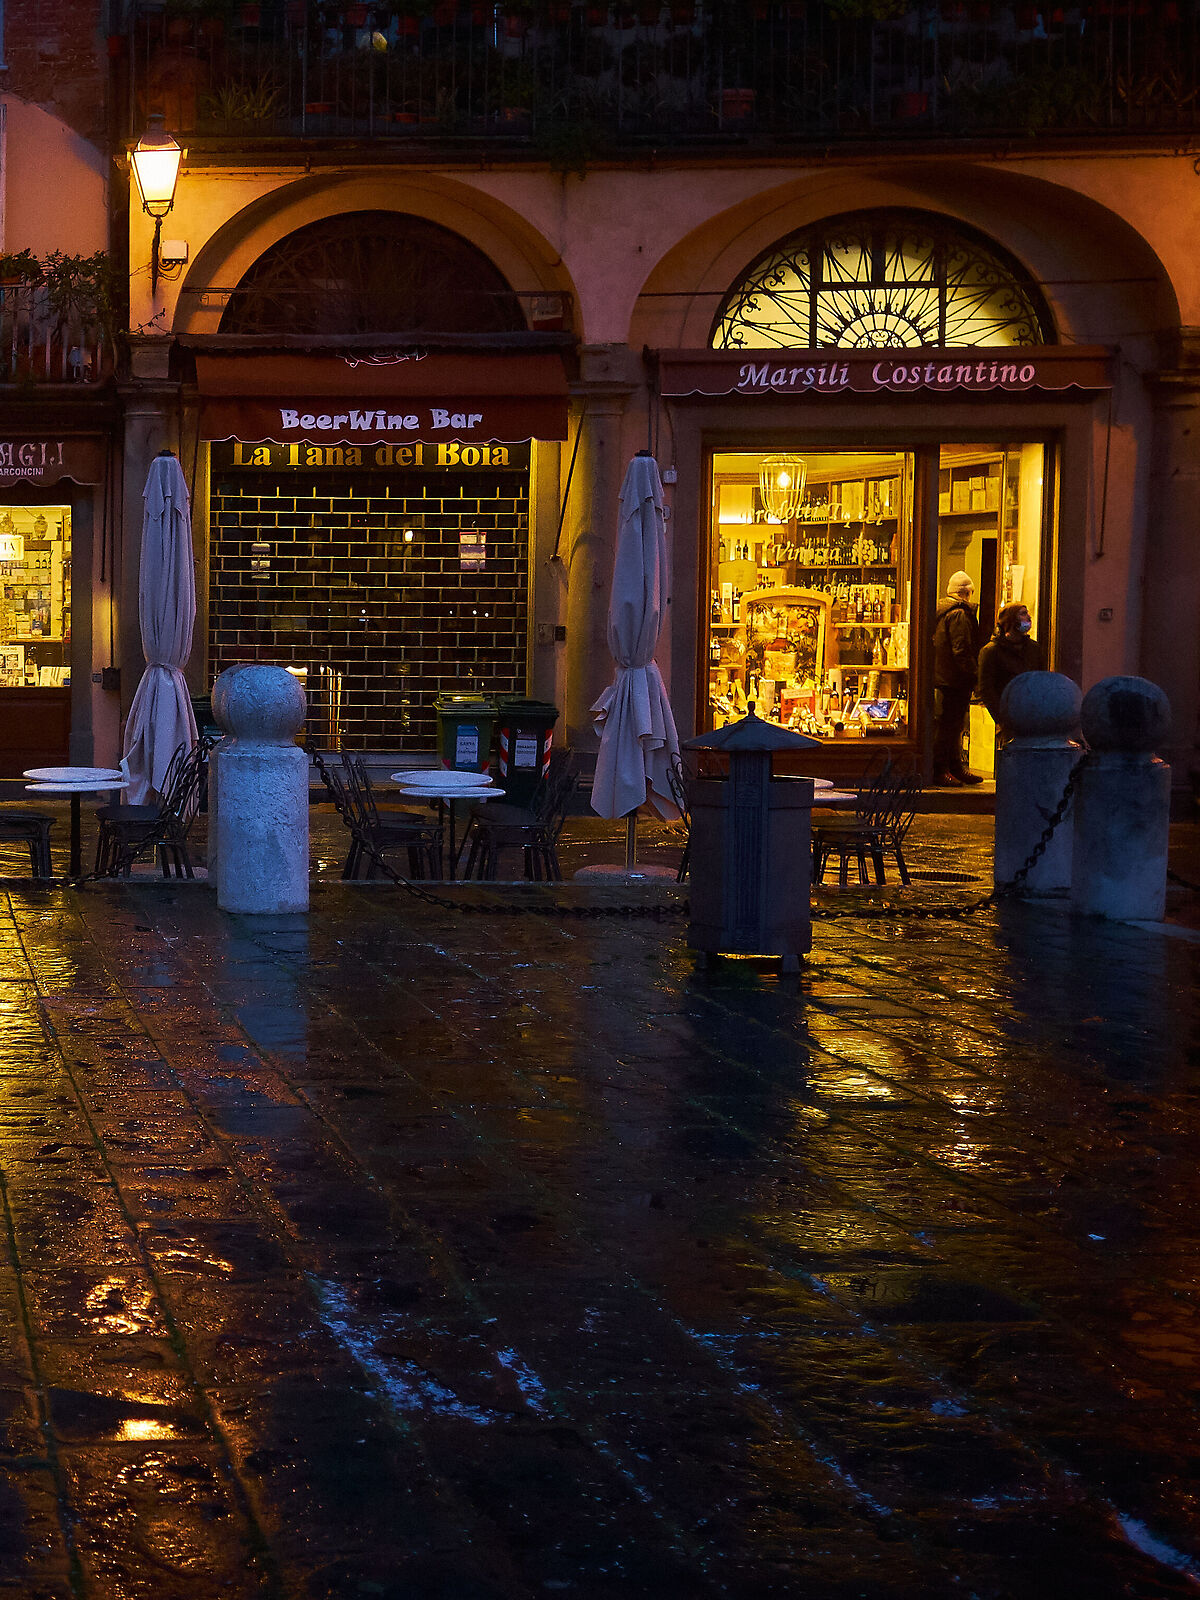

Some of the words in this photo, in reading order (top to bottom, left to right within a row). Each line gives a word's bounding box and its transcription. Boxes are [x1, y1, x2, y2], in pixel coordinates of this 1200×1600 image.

[738, 363, 849, 386] Marsili
[872, 362, 1036, 384] Costantino
[430, 408, 482, 430] Bar
[230, 444, 272, 466] La
[282, 443, 362, 466] Tana
[375, 444, 424, 466] del
[435, 444, 510, 466] Boia
